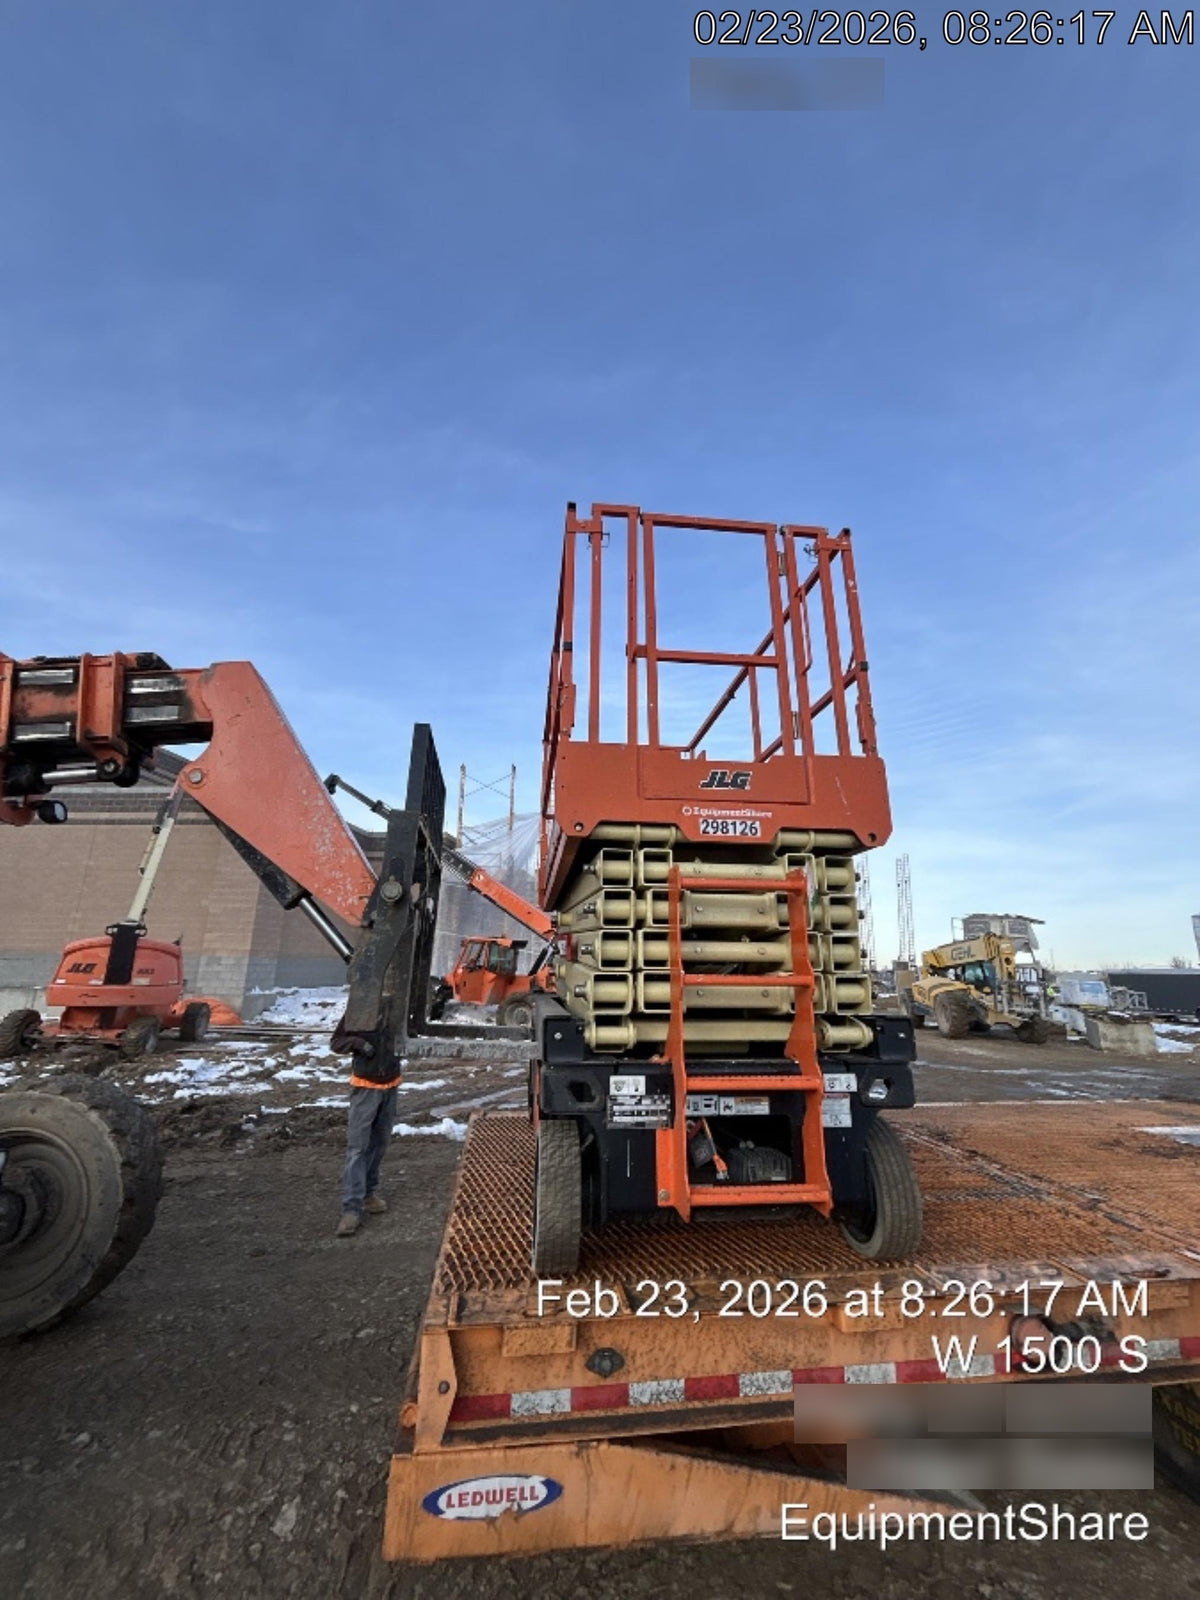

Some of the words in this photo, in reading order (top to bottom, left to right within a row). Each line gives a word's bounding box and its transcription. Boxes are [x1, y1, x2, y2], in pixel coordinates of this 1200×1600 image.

[699, 769, 752, 790] JLG
[701, 819, 759, 836] 298126
[445, 1485, 539, 1509] LEDWELL
